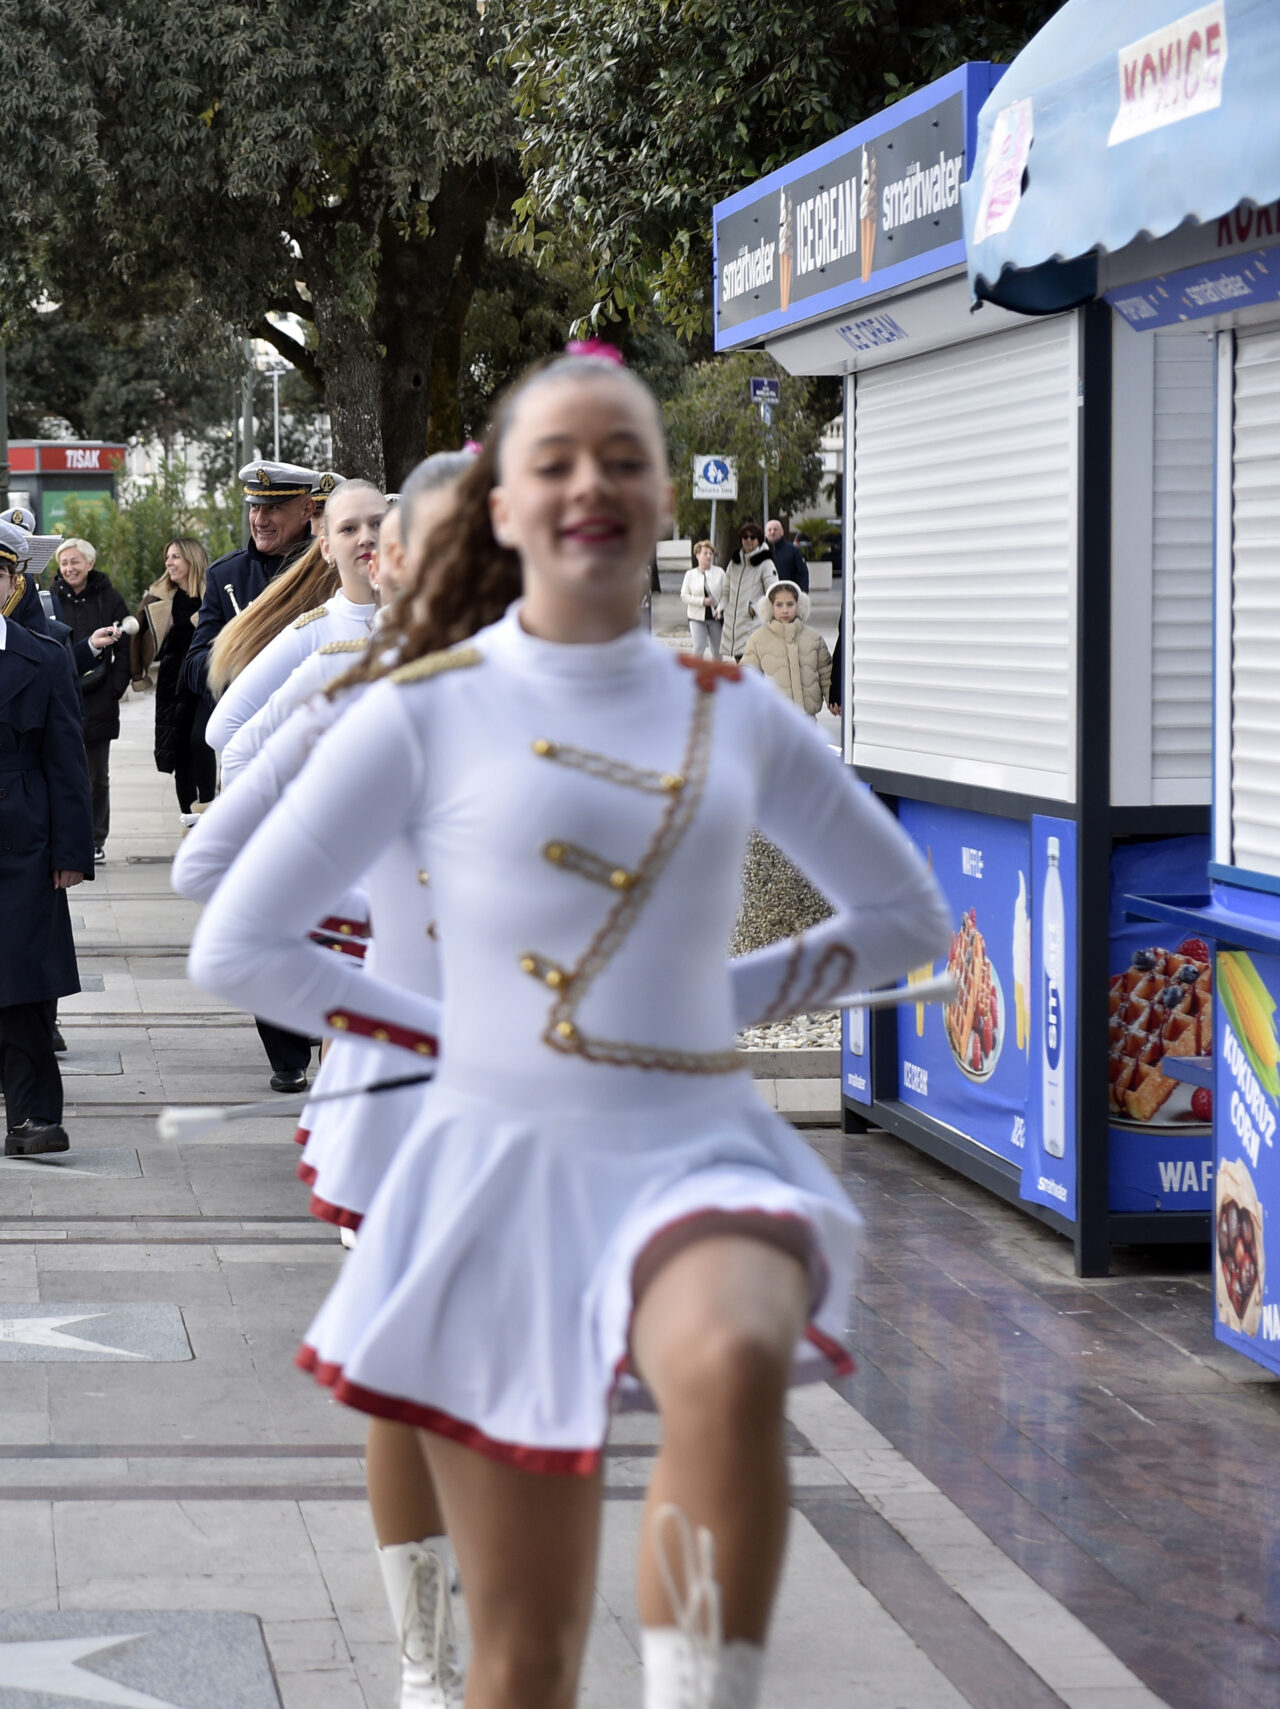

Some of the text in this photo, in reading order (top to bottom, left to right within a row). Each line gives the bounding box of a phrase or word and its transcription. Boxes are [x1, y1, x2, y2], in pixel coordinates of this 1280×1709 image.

[796, 176, 857, 277] ICE CREAM
[882, 150, 963, 232] smartwater
[722, 237, 776, 302] smartwater
[835, 313, 910, 352] ICE CREAM
[65, 449, 100, 469] TISAK
[1223, 1023, 1277, 1148] KUKURUZ
[1230, 1090, 1261, 1169] CORN
